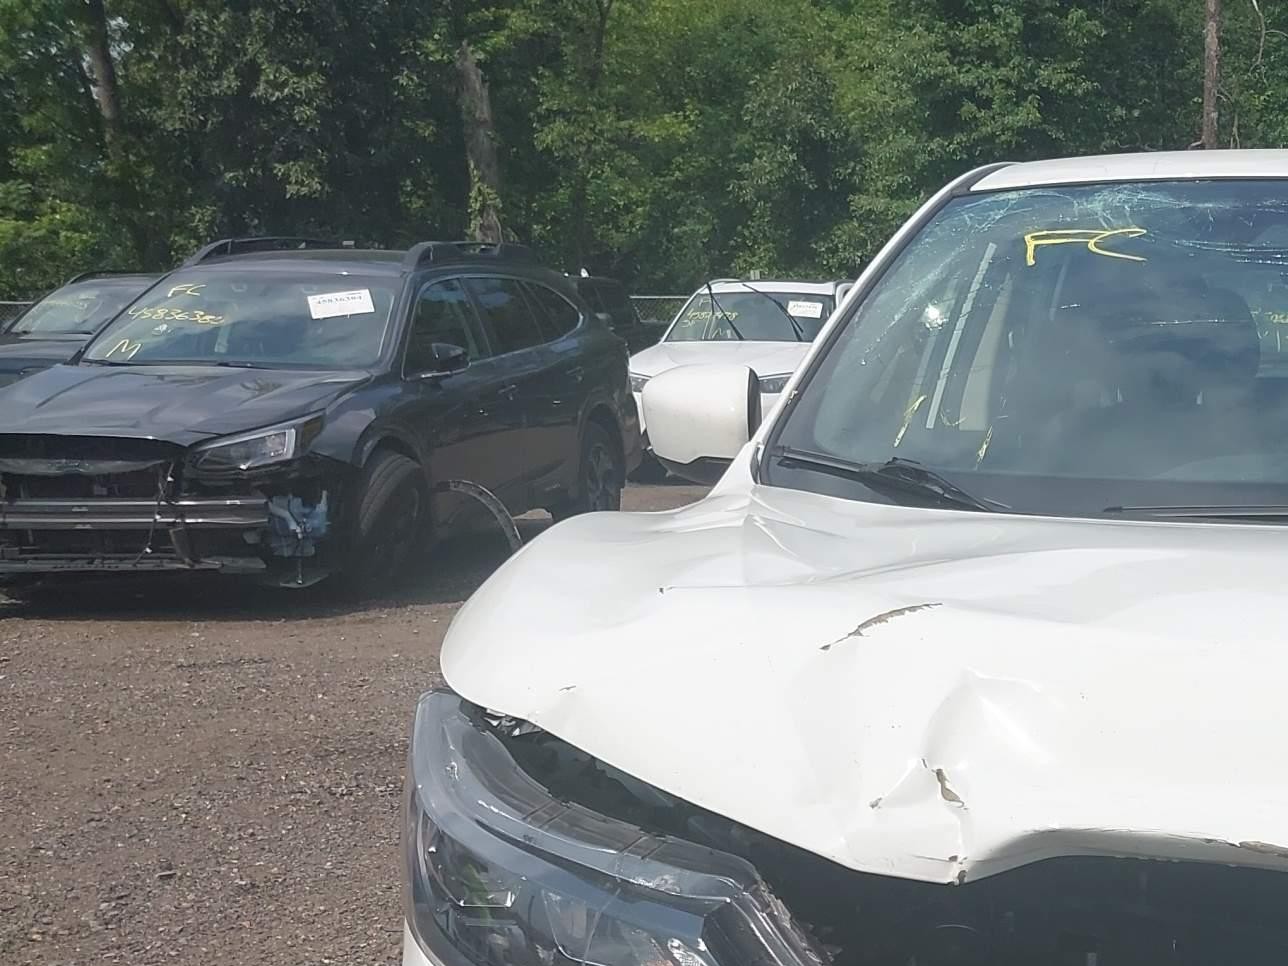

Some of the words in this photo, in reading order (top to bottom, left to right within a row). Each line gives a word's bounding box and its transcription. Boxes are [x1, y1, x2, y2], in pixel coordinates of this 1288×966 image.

[1024, 228, 1148, 266] FC
[167, 283, 207, 298] FC
[105, 339, 142, 360] M
